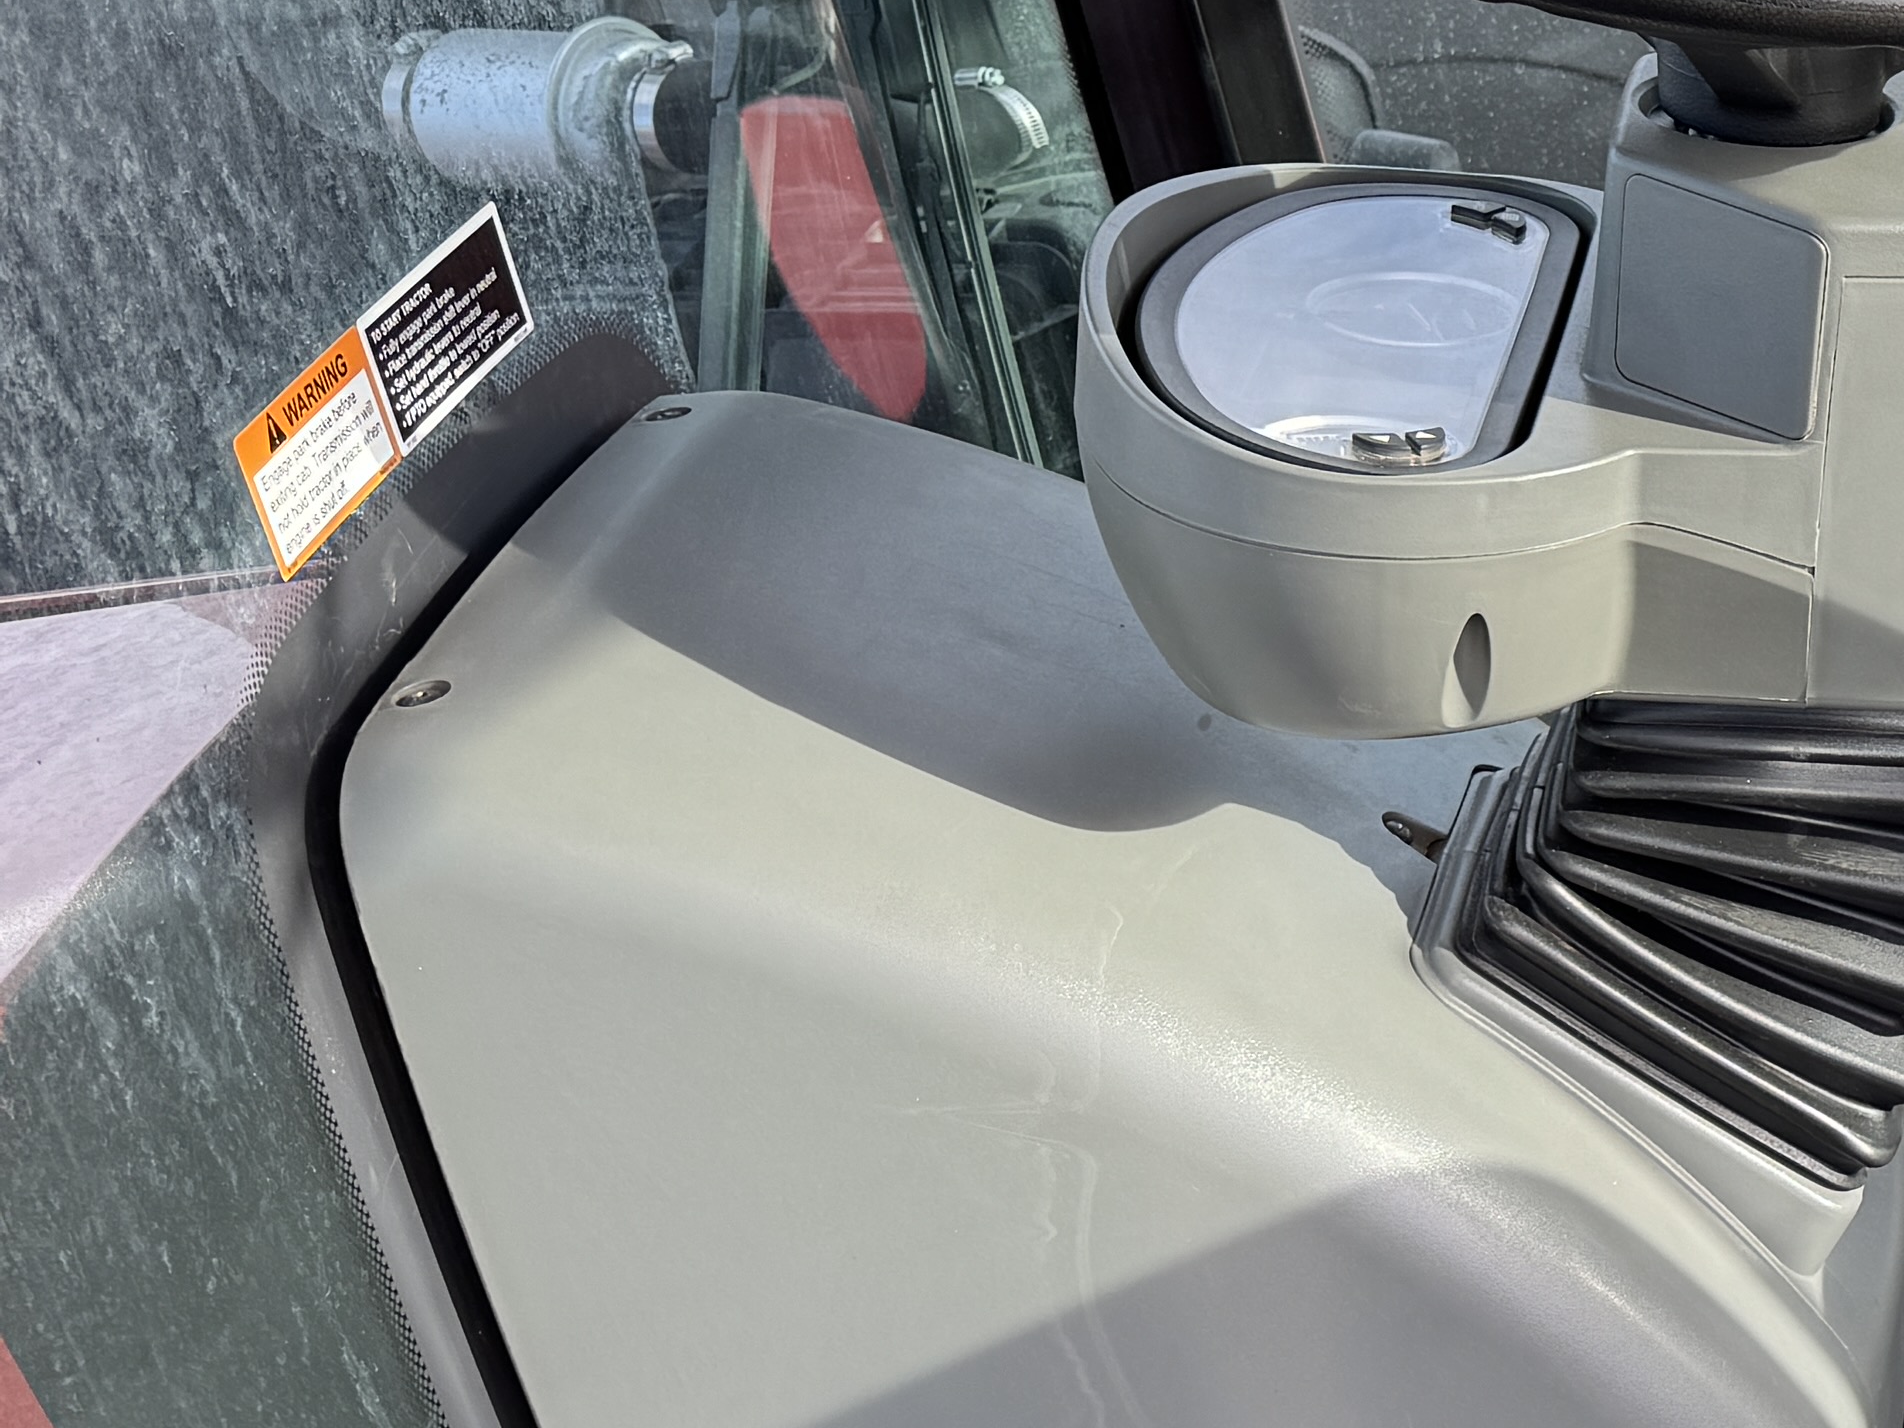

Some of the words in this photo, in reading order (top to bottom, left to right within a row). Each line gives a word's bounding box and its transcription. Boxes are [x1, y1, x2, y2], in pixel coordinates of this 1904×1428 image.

[380, 308, 401, 335] START
[400, 283, 431, 315] TRACTOR
[282, 354, 347, 425] WARNING
[261, 456, 292, 491] Engage
[309, 416, 332, 442] brake
[331, 392, 356, 421] before
[312, 415, 361, 465] Transmission
[363, 421, 382, 444] when
